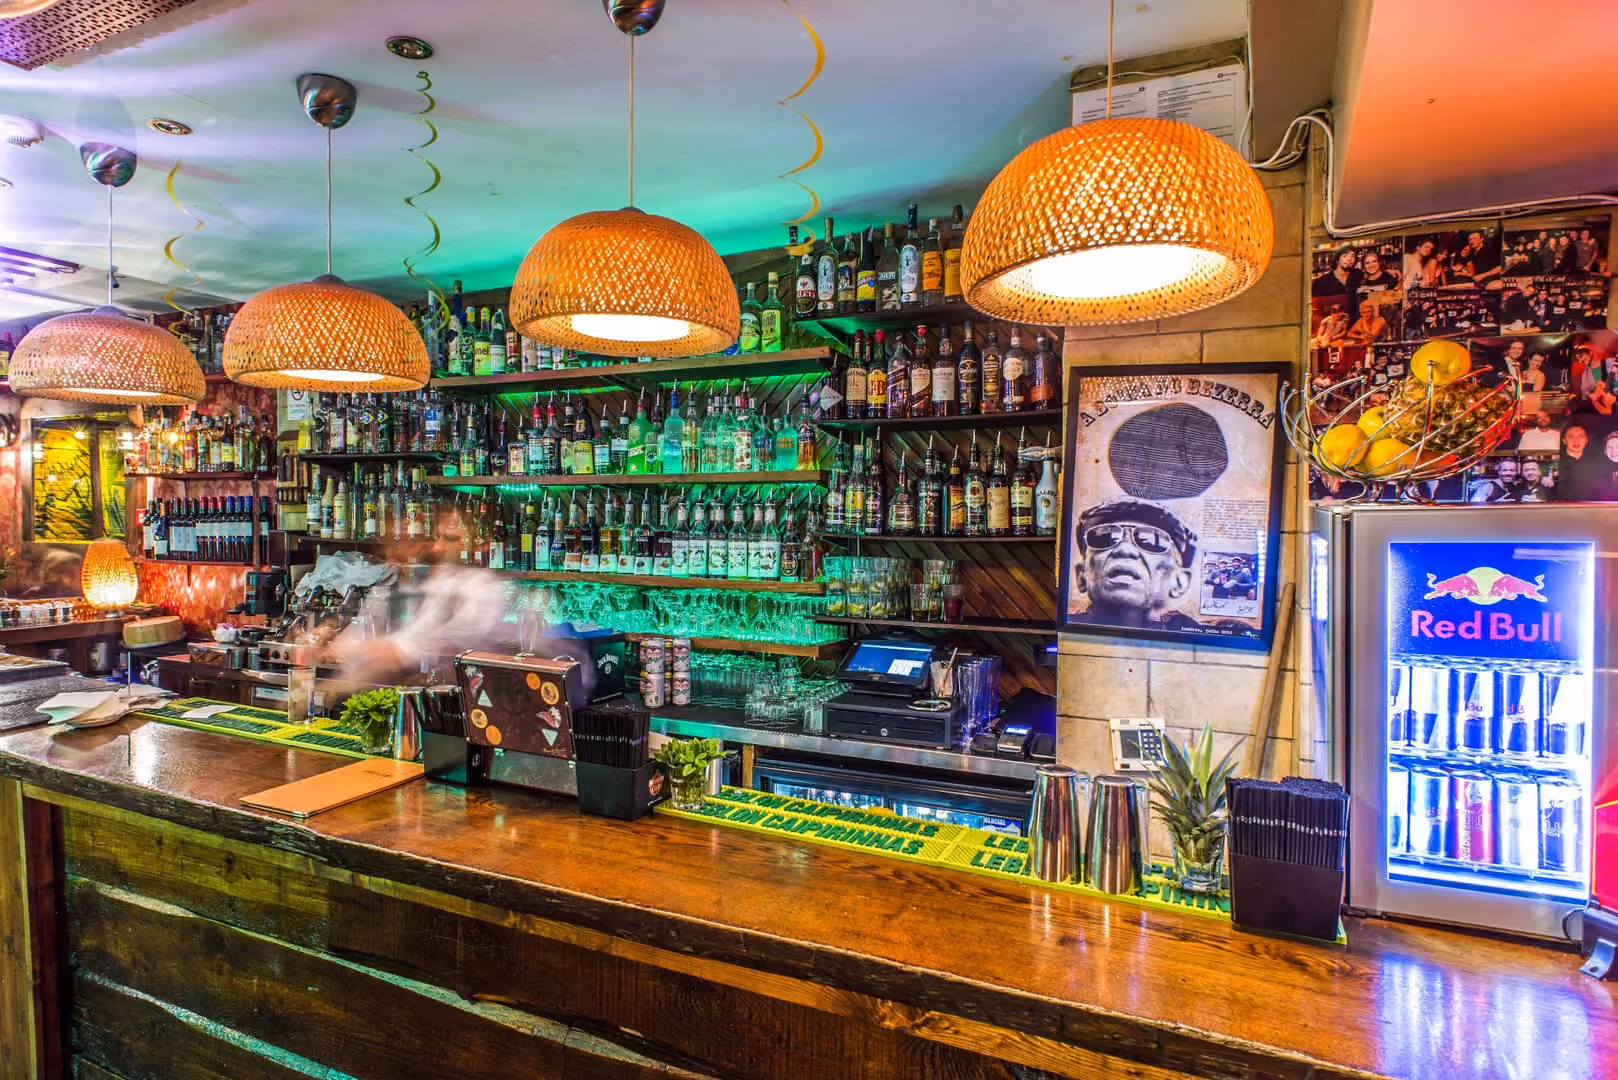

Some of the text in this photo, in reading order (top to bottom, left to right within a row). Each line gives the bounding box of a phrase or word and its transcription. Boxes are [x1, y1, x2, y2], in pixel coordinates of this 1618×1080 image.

[1186, 377, 1276, 430] BEZERRA
[1411, 610, 1563, 643] Red Bull
[761, 814, 925, 855] CAIPIRINHAS
[784, 799, 939, 838] CAIPIRINHAS
